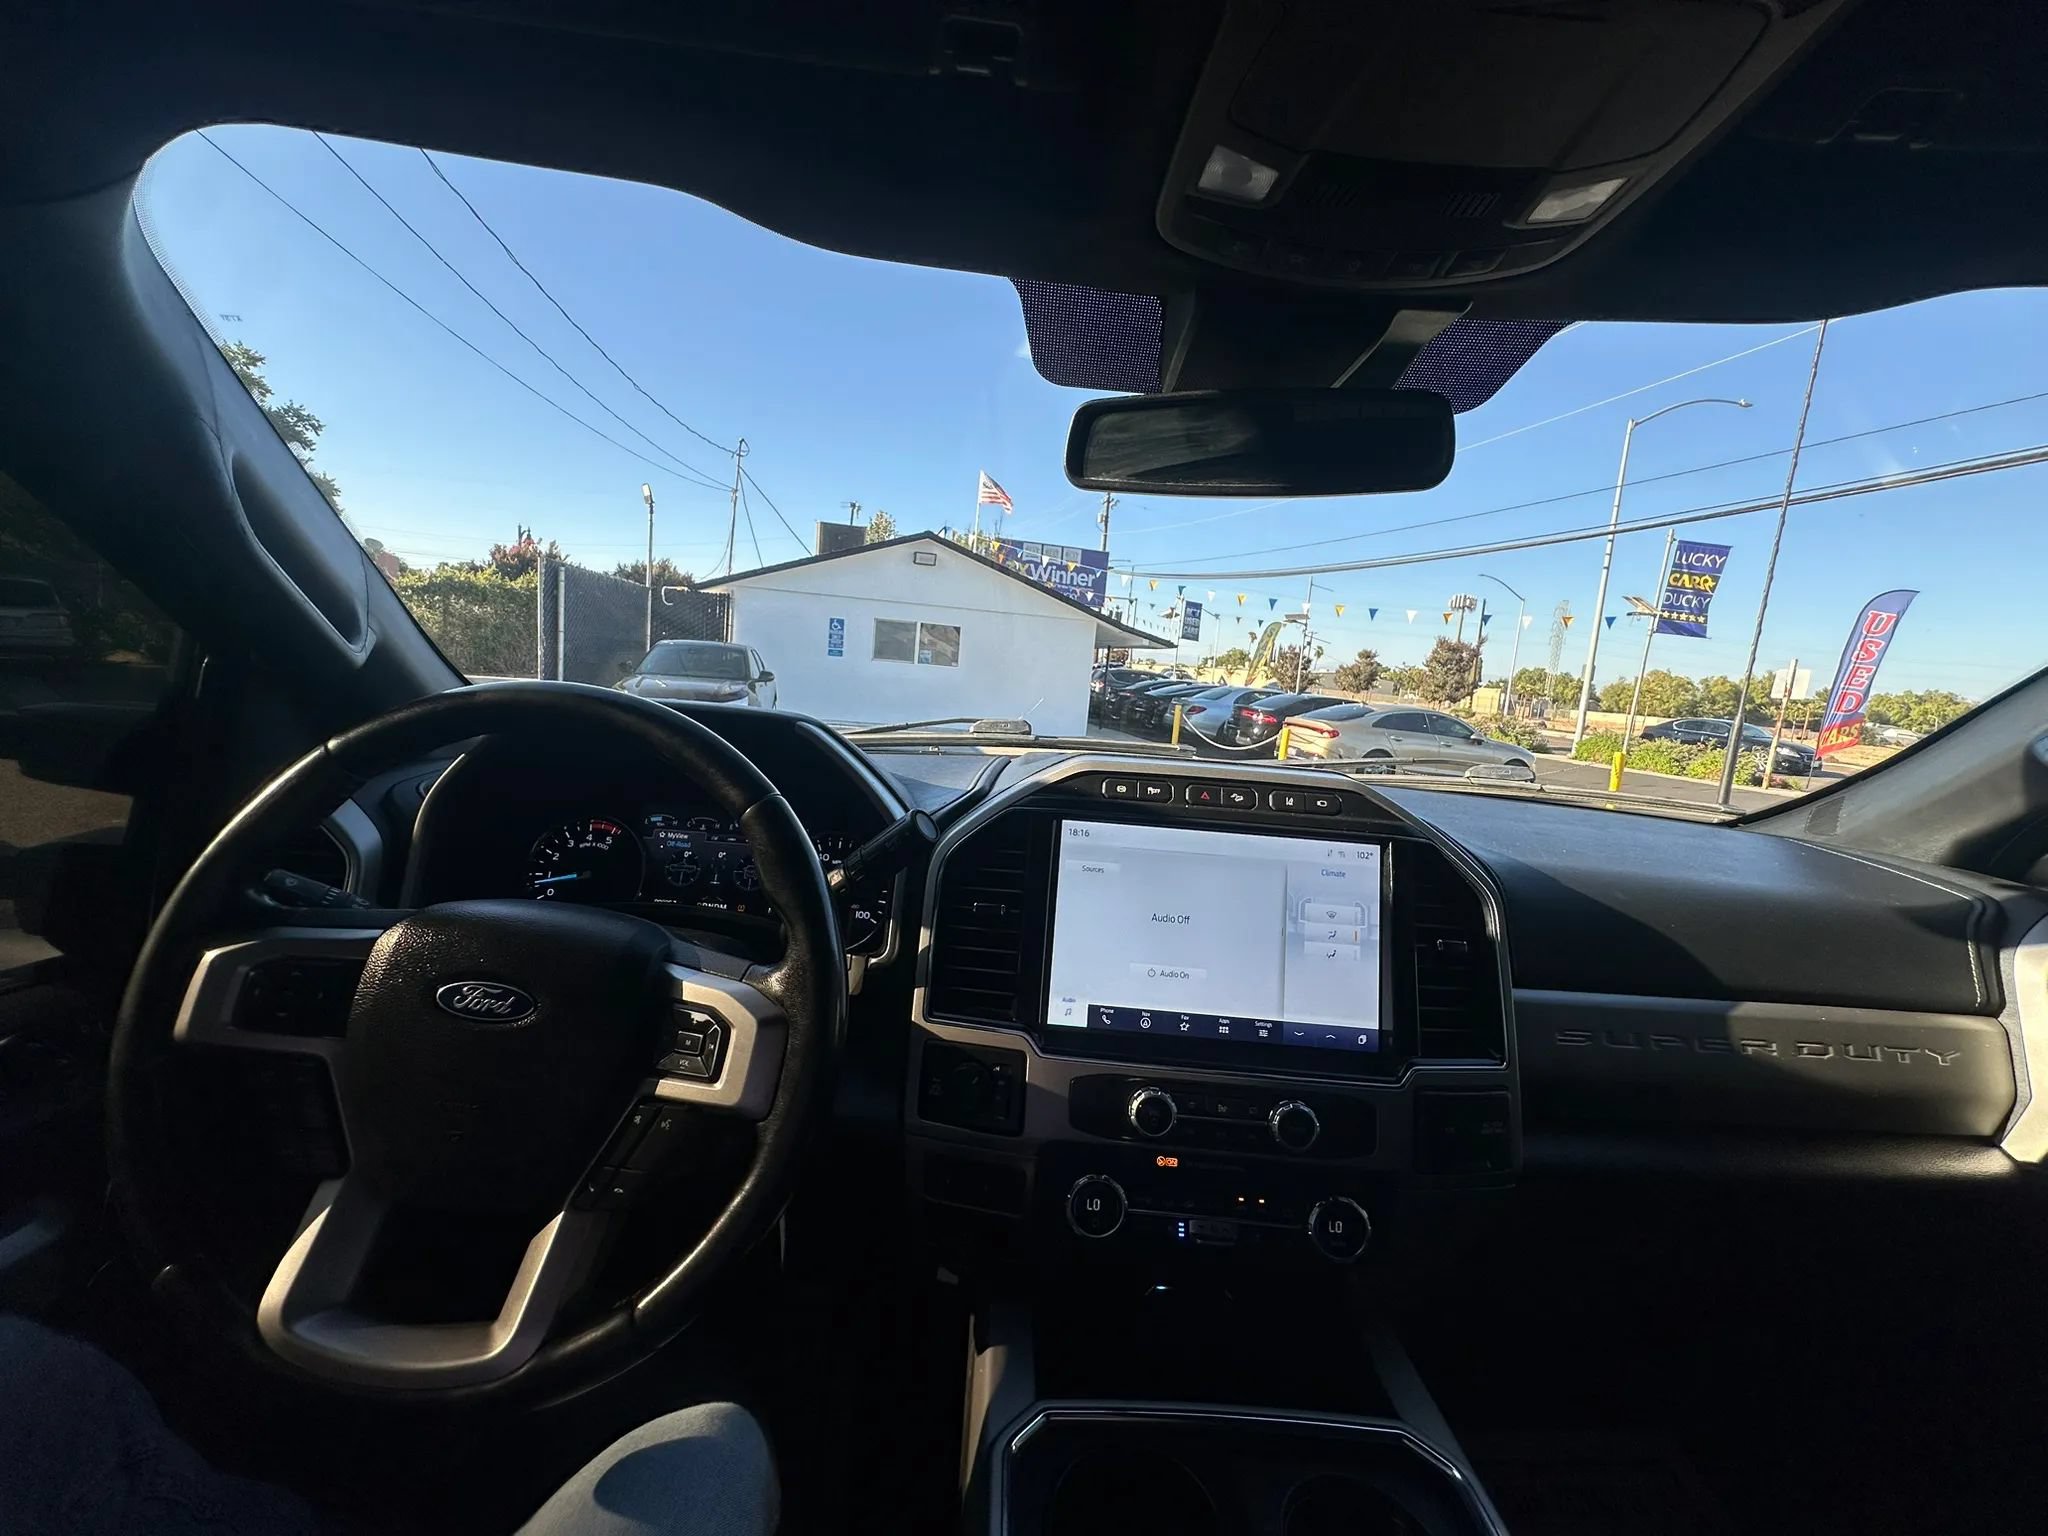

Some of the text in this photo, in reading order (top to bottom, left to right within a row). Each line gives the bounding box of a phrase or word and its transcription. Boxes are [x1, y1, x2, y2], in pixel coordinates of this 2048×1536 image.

[1674, 550, 1726, 569] LUCKY
[1669, 573, 1716, 592] CARS
[1663, 592, 1710, 608] DUCKY
[1834, 610, 1898, 715] USED
[1820, 723, 1860, 748] CARS
[667, 832, 689, 840] MyView
[1068, 828, 1090, 838] 18:16
[567, 840, 575, 848] 3
[605, 836, 613, 845] 5
[552, 852, 560, 861] 2
[1081, 864, 1105, 874] Sources
[1320, 869, 1346, 879] Climate
[546, 888, 555, 896] 0
[855, 911, 871, 919] 100
[1151, 912, 1191, 924] Audio Off
[1160, 969, 1190, 979] Audio On
[453, 985, 516, 1014] Ford
[1254, 1020, 1273, 1029] Settings
[1555, 1030, 1960, 1066] SUPER DUTY
[1086, 1198, 1101, 1211] LO
[1328, 1219, 1343, 1233] LO
